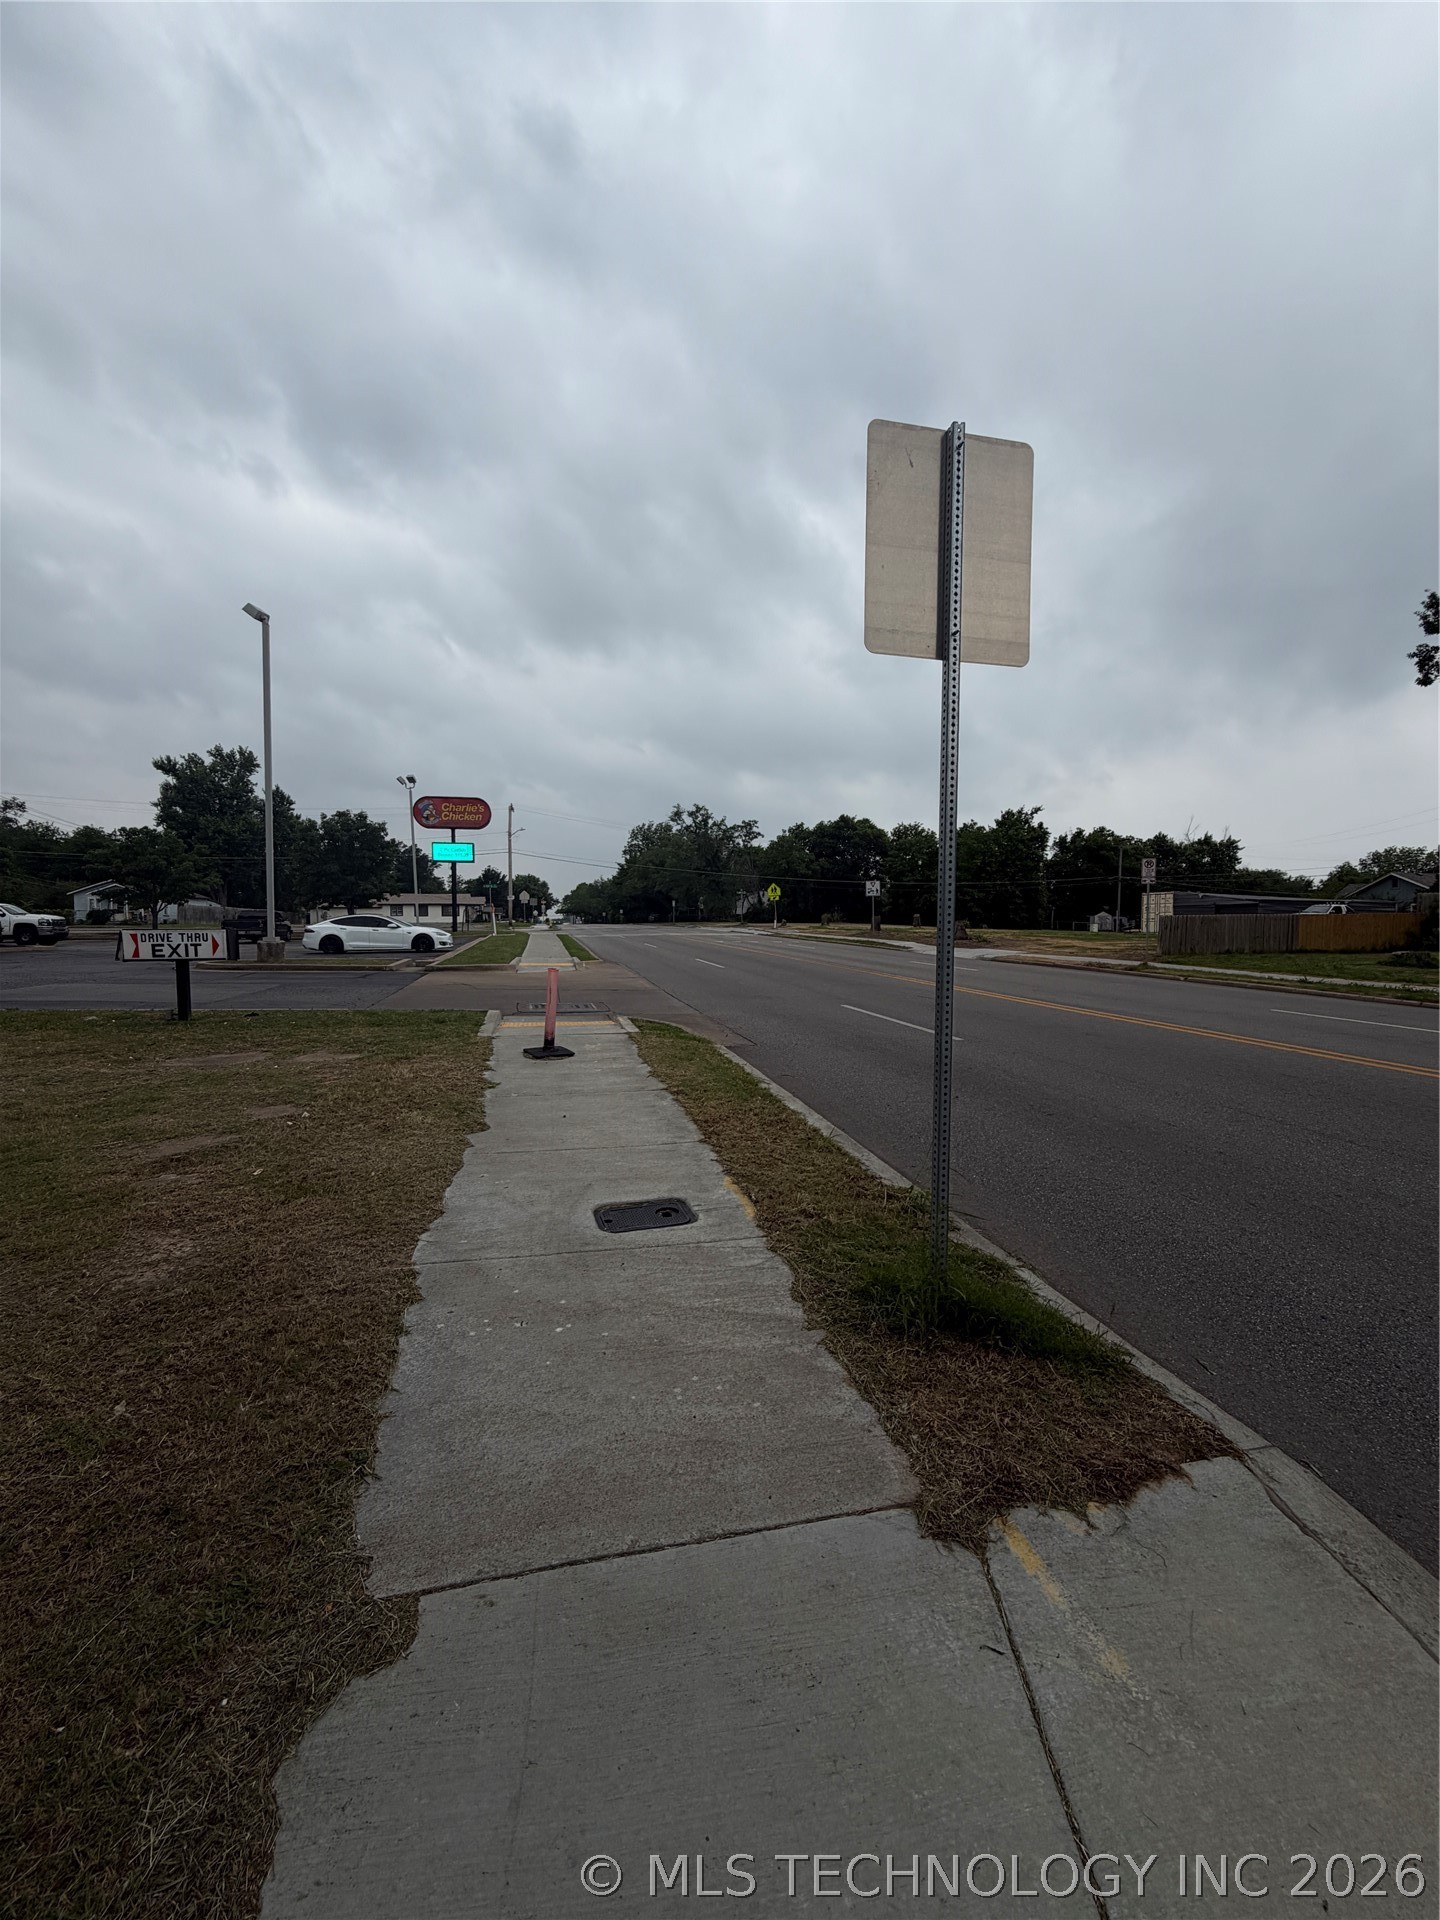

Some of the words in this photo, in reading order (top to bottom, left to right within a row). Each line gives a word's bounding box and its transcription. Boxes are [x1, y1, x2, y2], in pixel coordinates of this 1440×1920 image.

[441, 802, 485, 812] Charlie's
[441, 812, 482, 821] Chicken
[140, 932, 173, 943] DRIVE
[178, 932, 209, 943] THRU
[150, 943, 202, 958] EXIT
